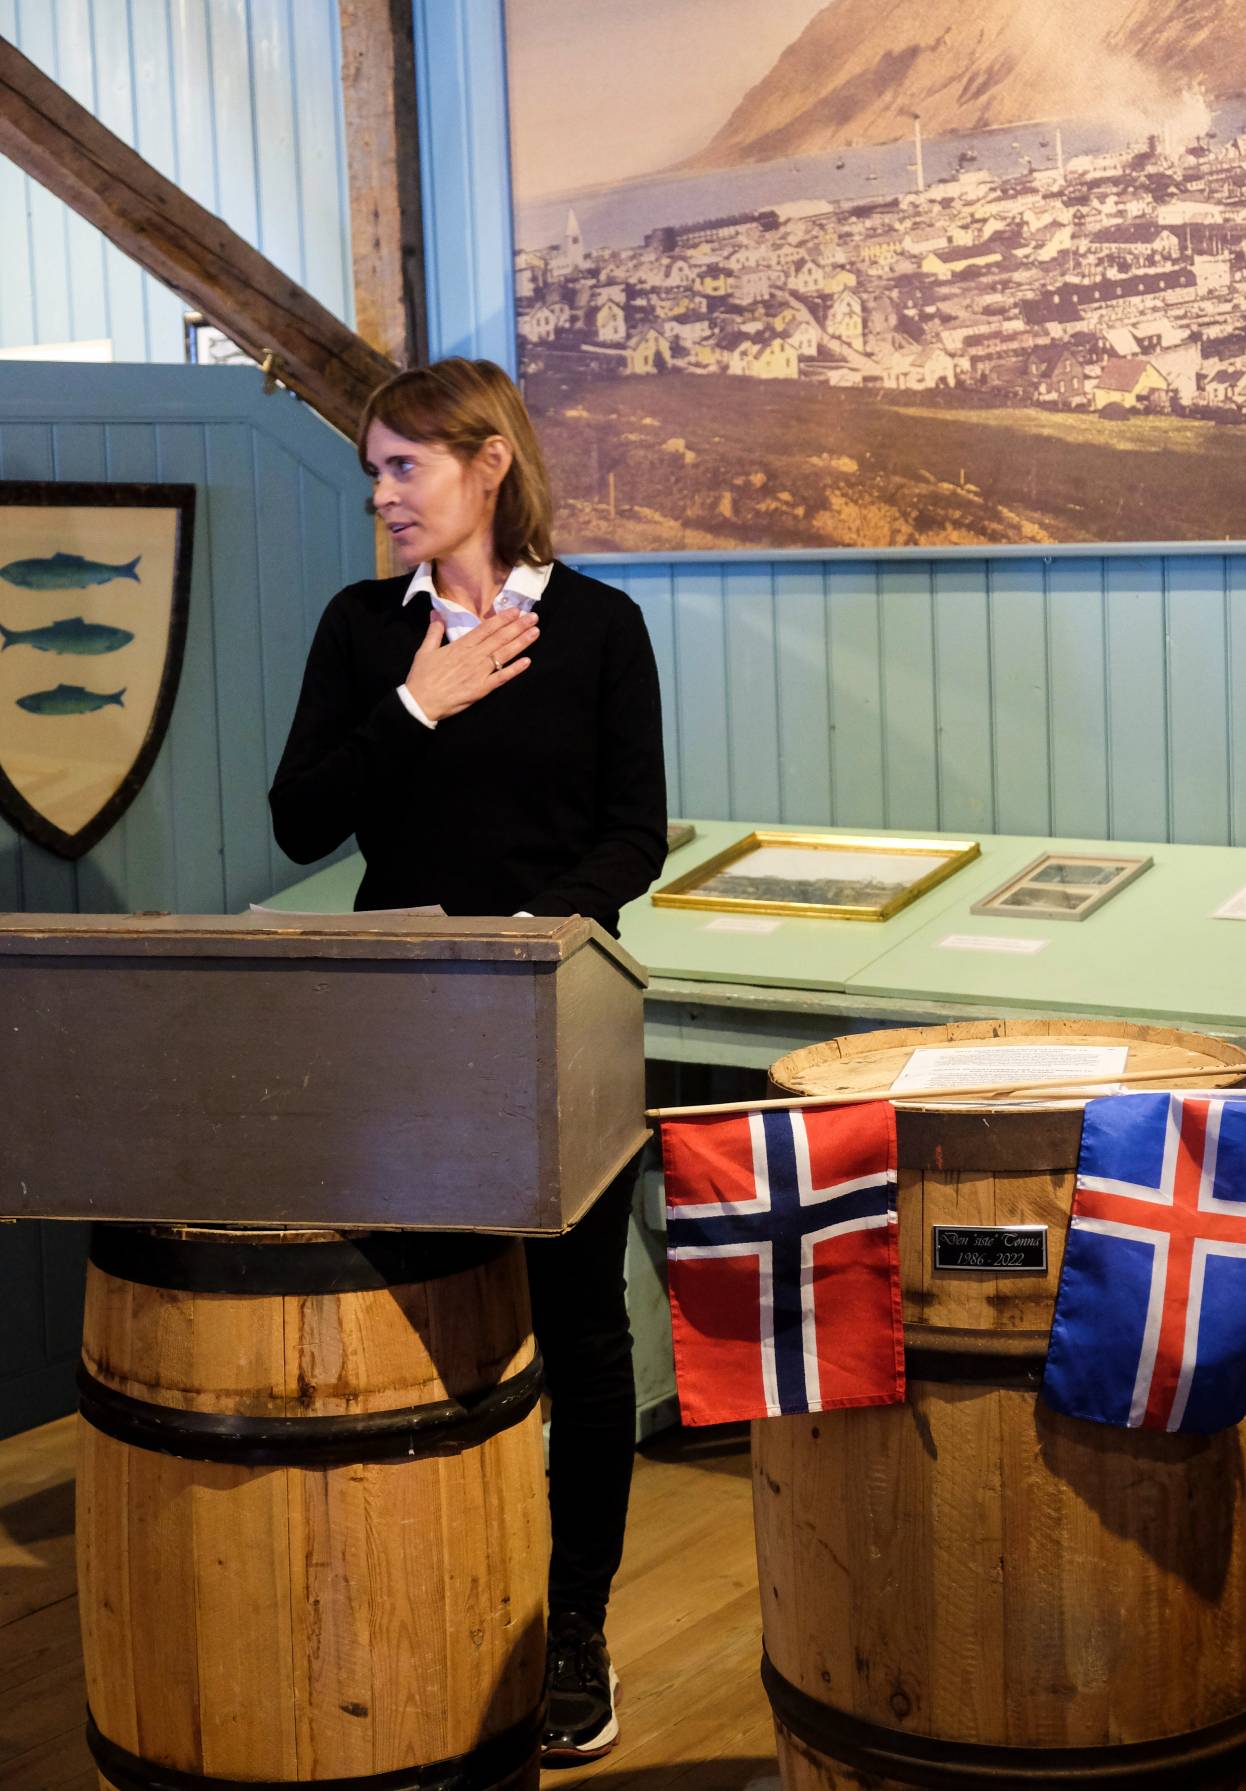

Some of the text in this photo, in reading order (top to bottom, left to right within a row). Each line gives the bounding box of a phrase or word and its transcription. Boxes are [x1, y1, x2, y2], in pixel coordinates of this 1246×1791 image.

[942, 1232, 968, 1246] Den
[957, 1252, 984, 1265] 1986
[993, 1252, 1025, 1266] 2022
